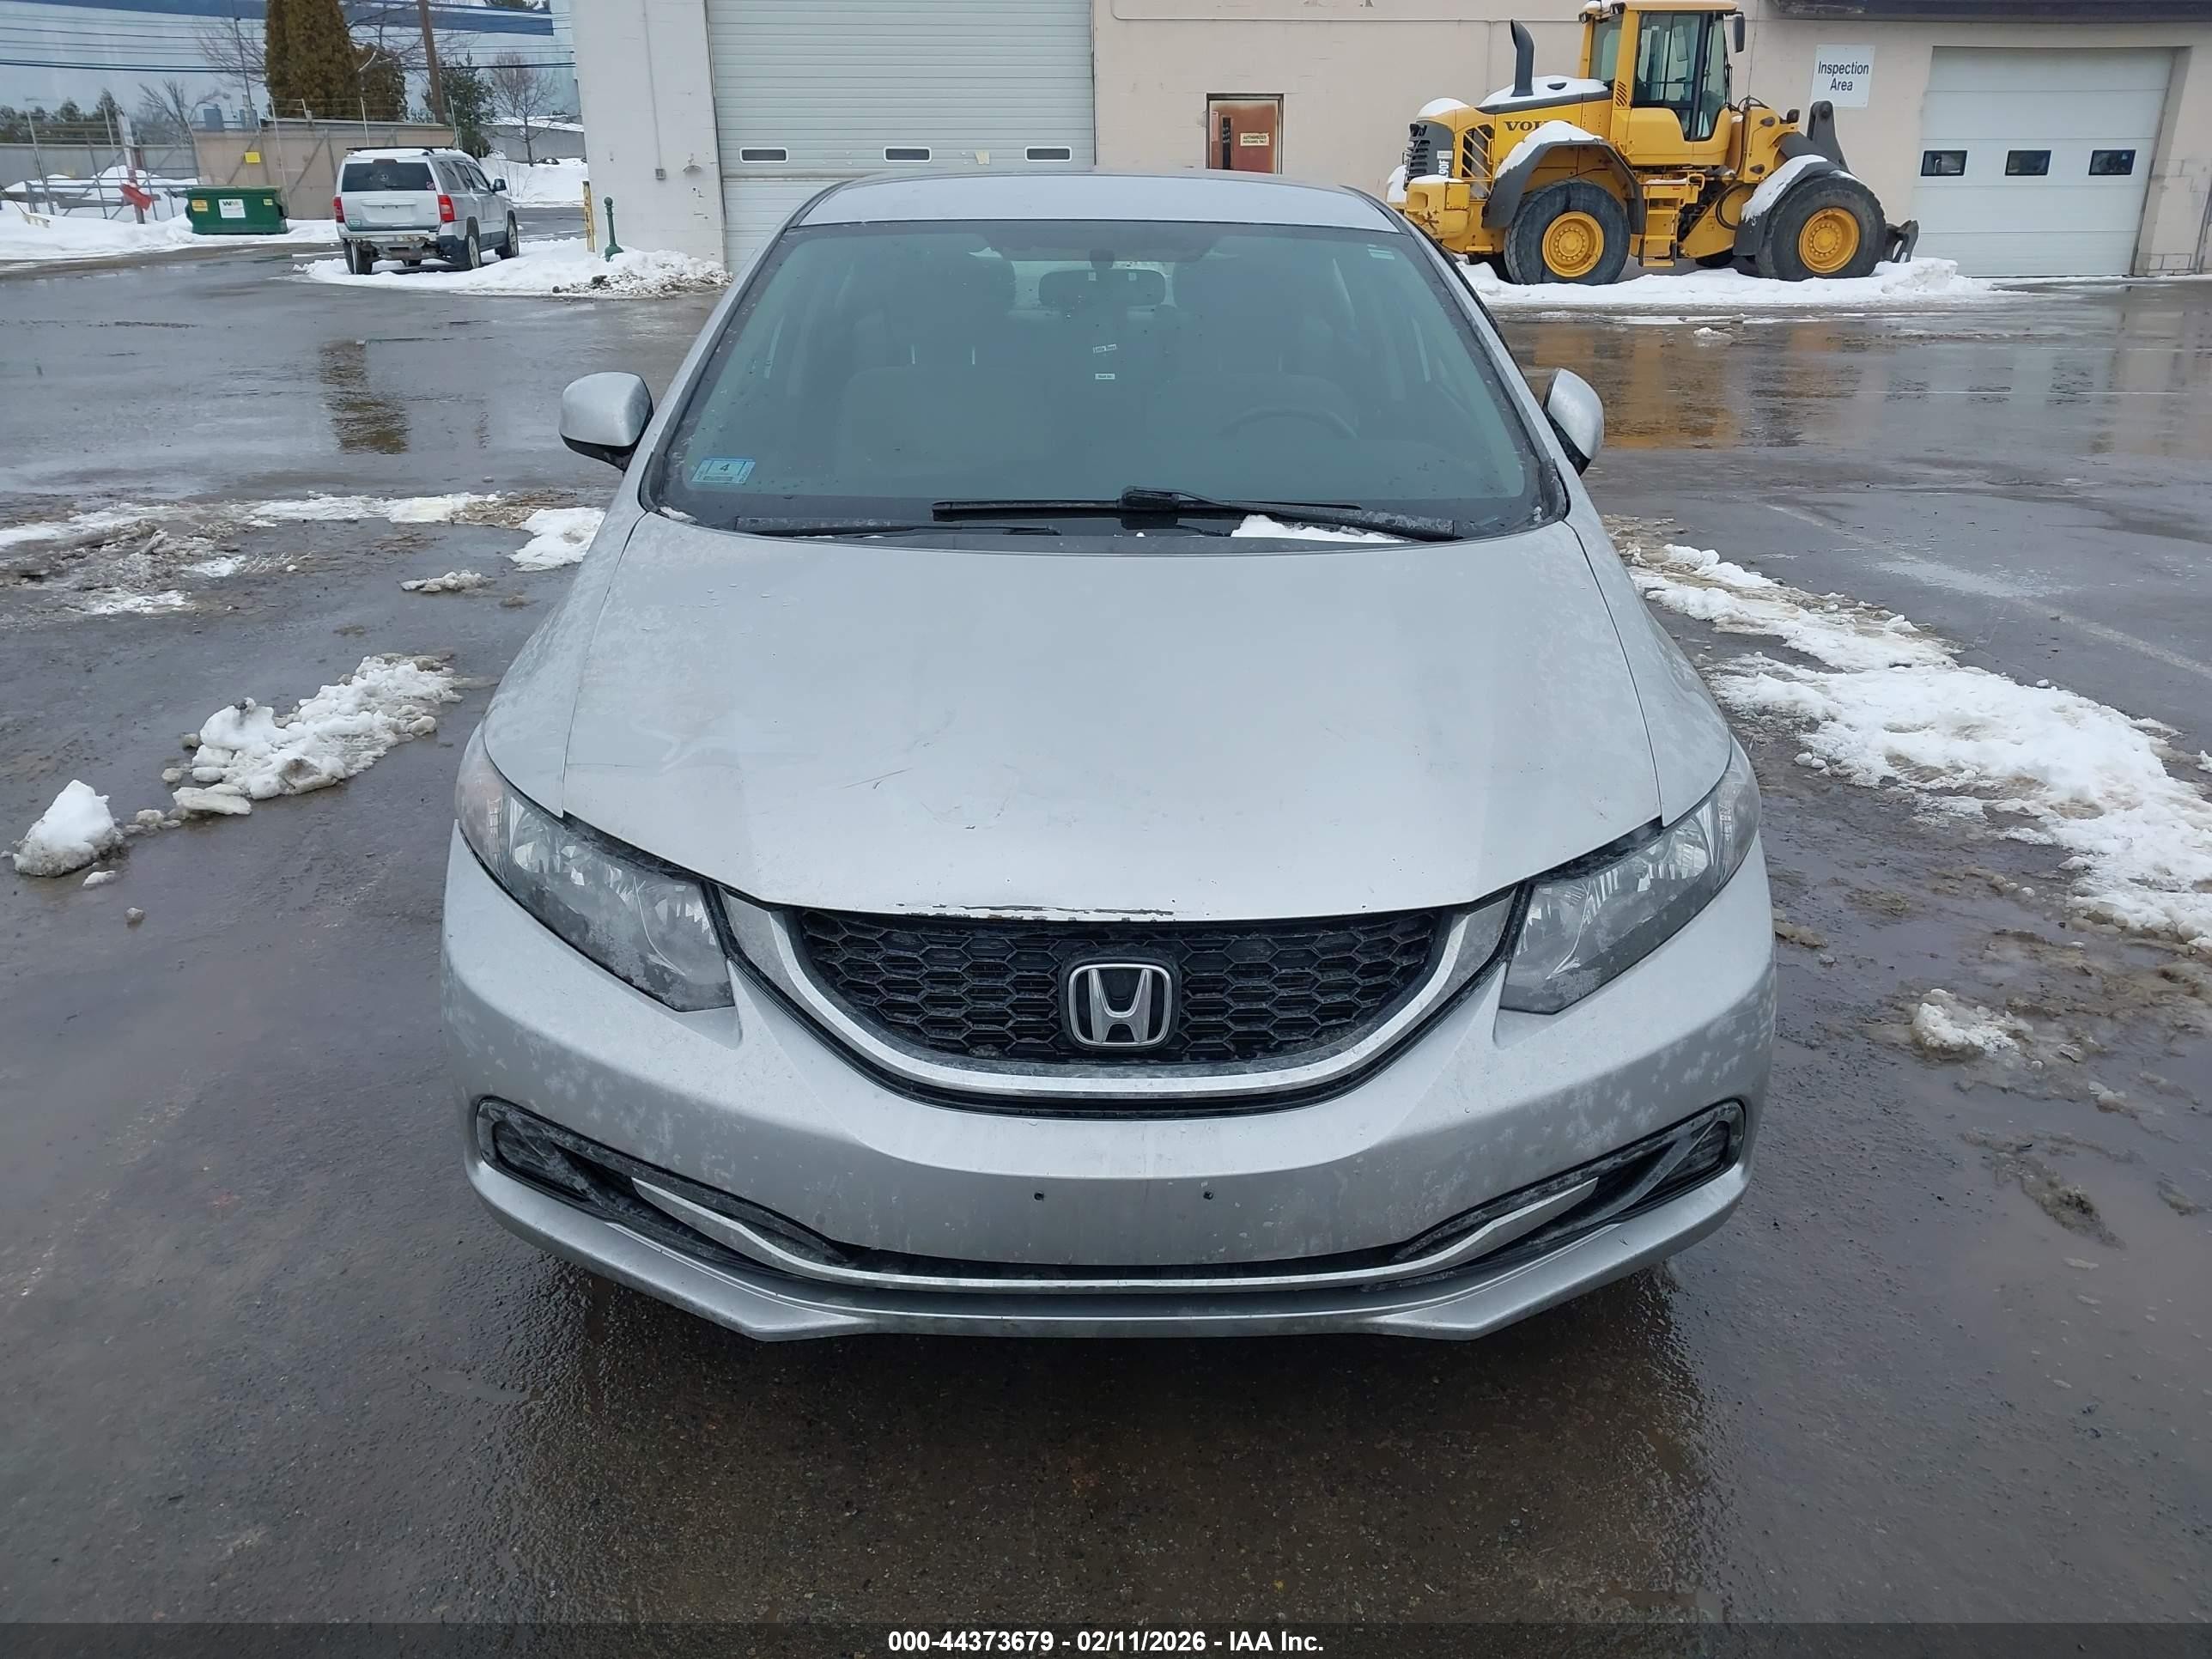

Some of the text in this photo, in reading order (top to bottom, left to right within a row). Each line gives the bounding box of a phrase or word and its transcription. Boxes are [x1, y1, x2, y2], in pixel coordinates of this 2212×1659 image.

[1817, 61, 1869, 76] Inspection
[1829, 77, 1853, 91] Area
[720, 463, 730, 472] 4
